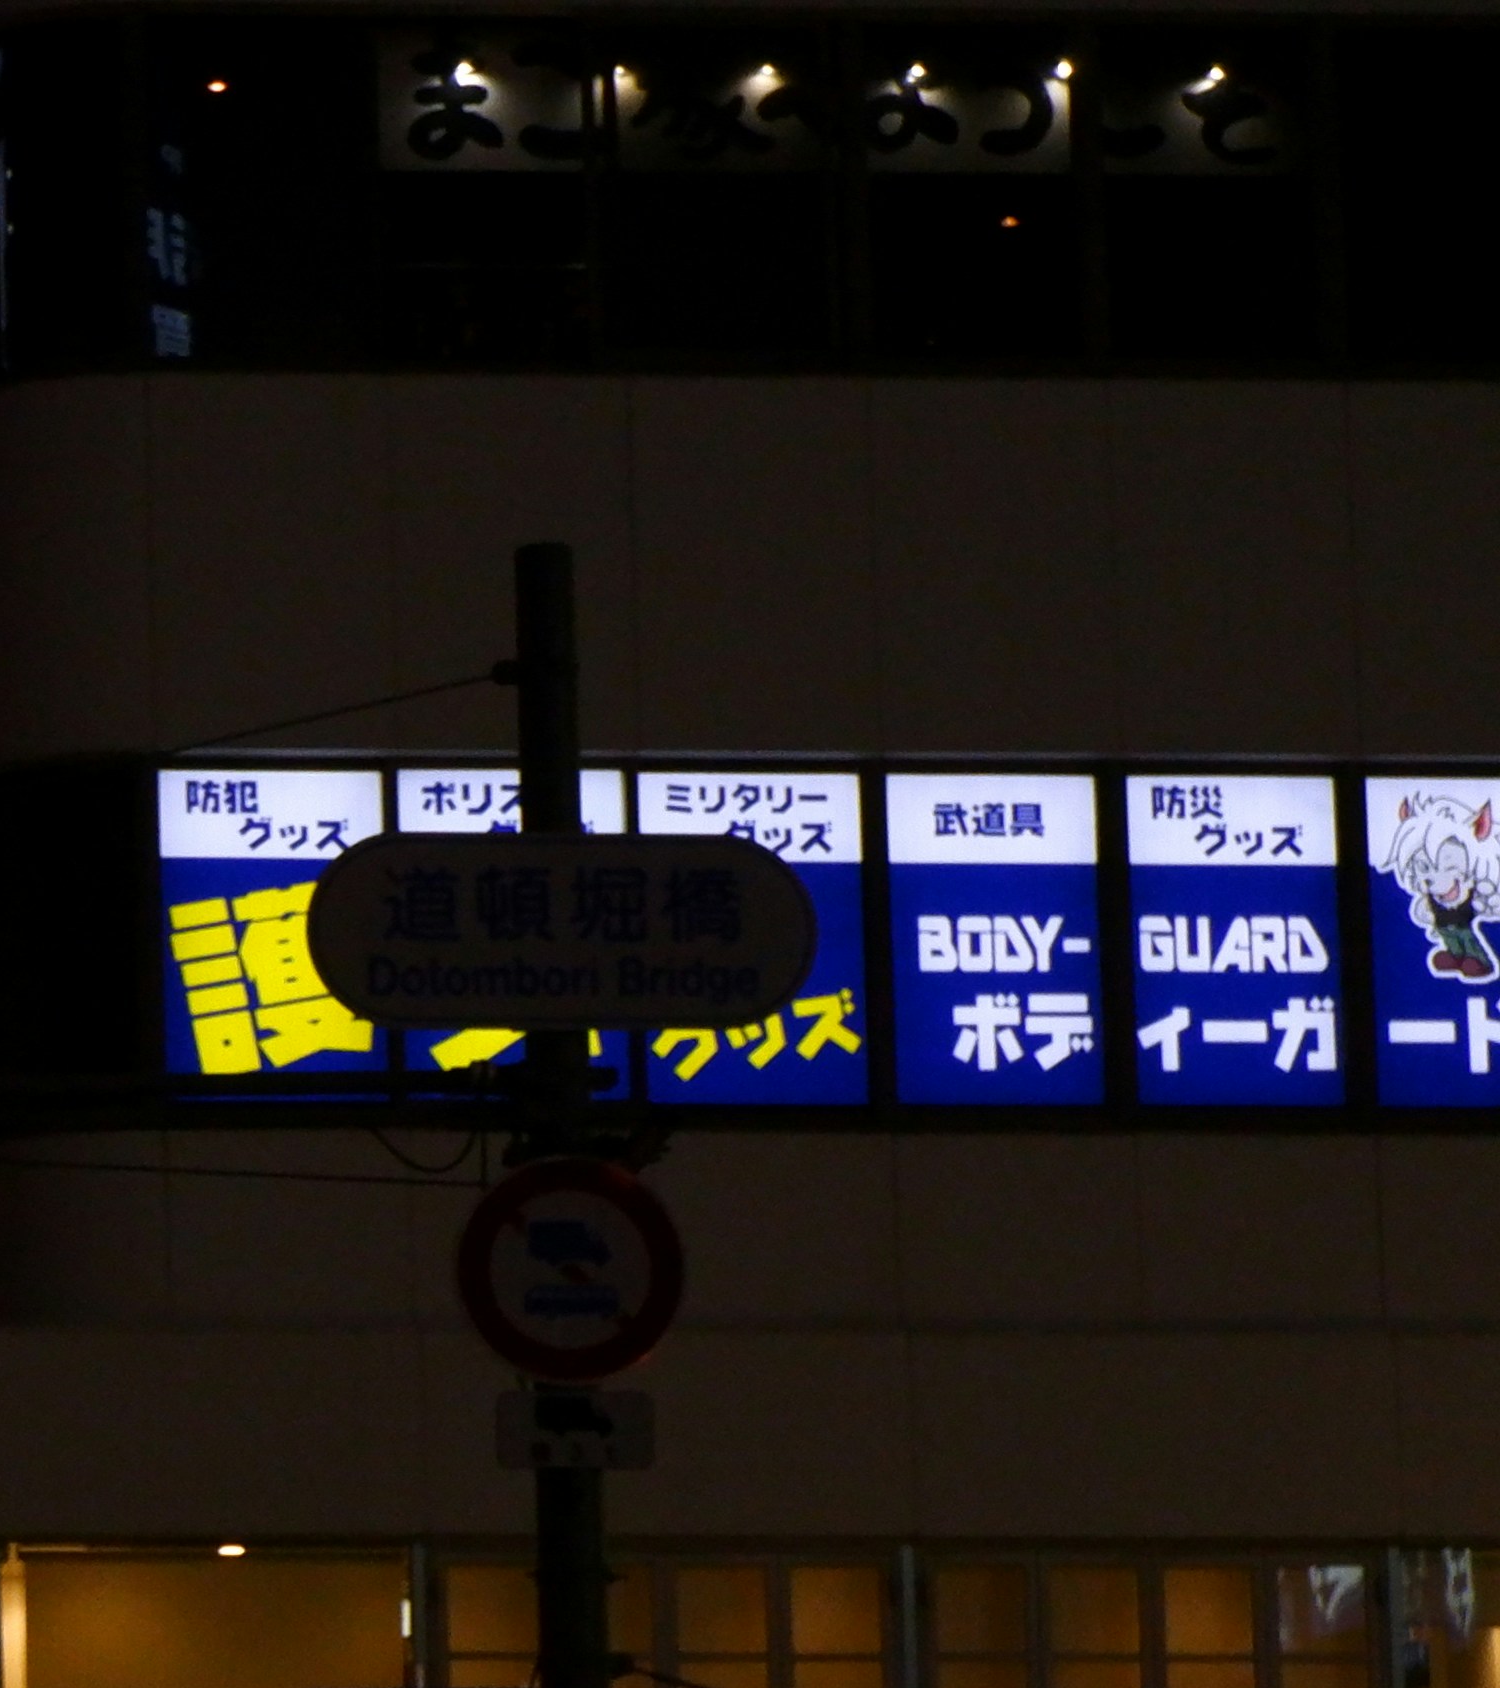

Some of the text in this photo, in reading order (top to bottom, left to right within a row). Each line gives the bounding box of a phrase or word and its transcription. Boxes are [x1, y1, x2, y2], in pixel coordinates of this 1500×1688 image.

[186, 781, 258, 814] 防犯
[666, 785, 828, 813] ミリタリー
[1152, 786, 1222, 818] 防災
[239, 818, 349, 851] グッズ
[934, 803, 1044, 837] 武道具
[1195, 823, 1302, 857] グッズ
[383, 866, 742, 944] 道頓堀橋
[1140, 916, 1328, 972] GUARD
[618, 957, 759, 1004] Bridge
